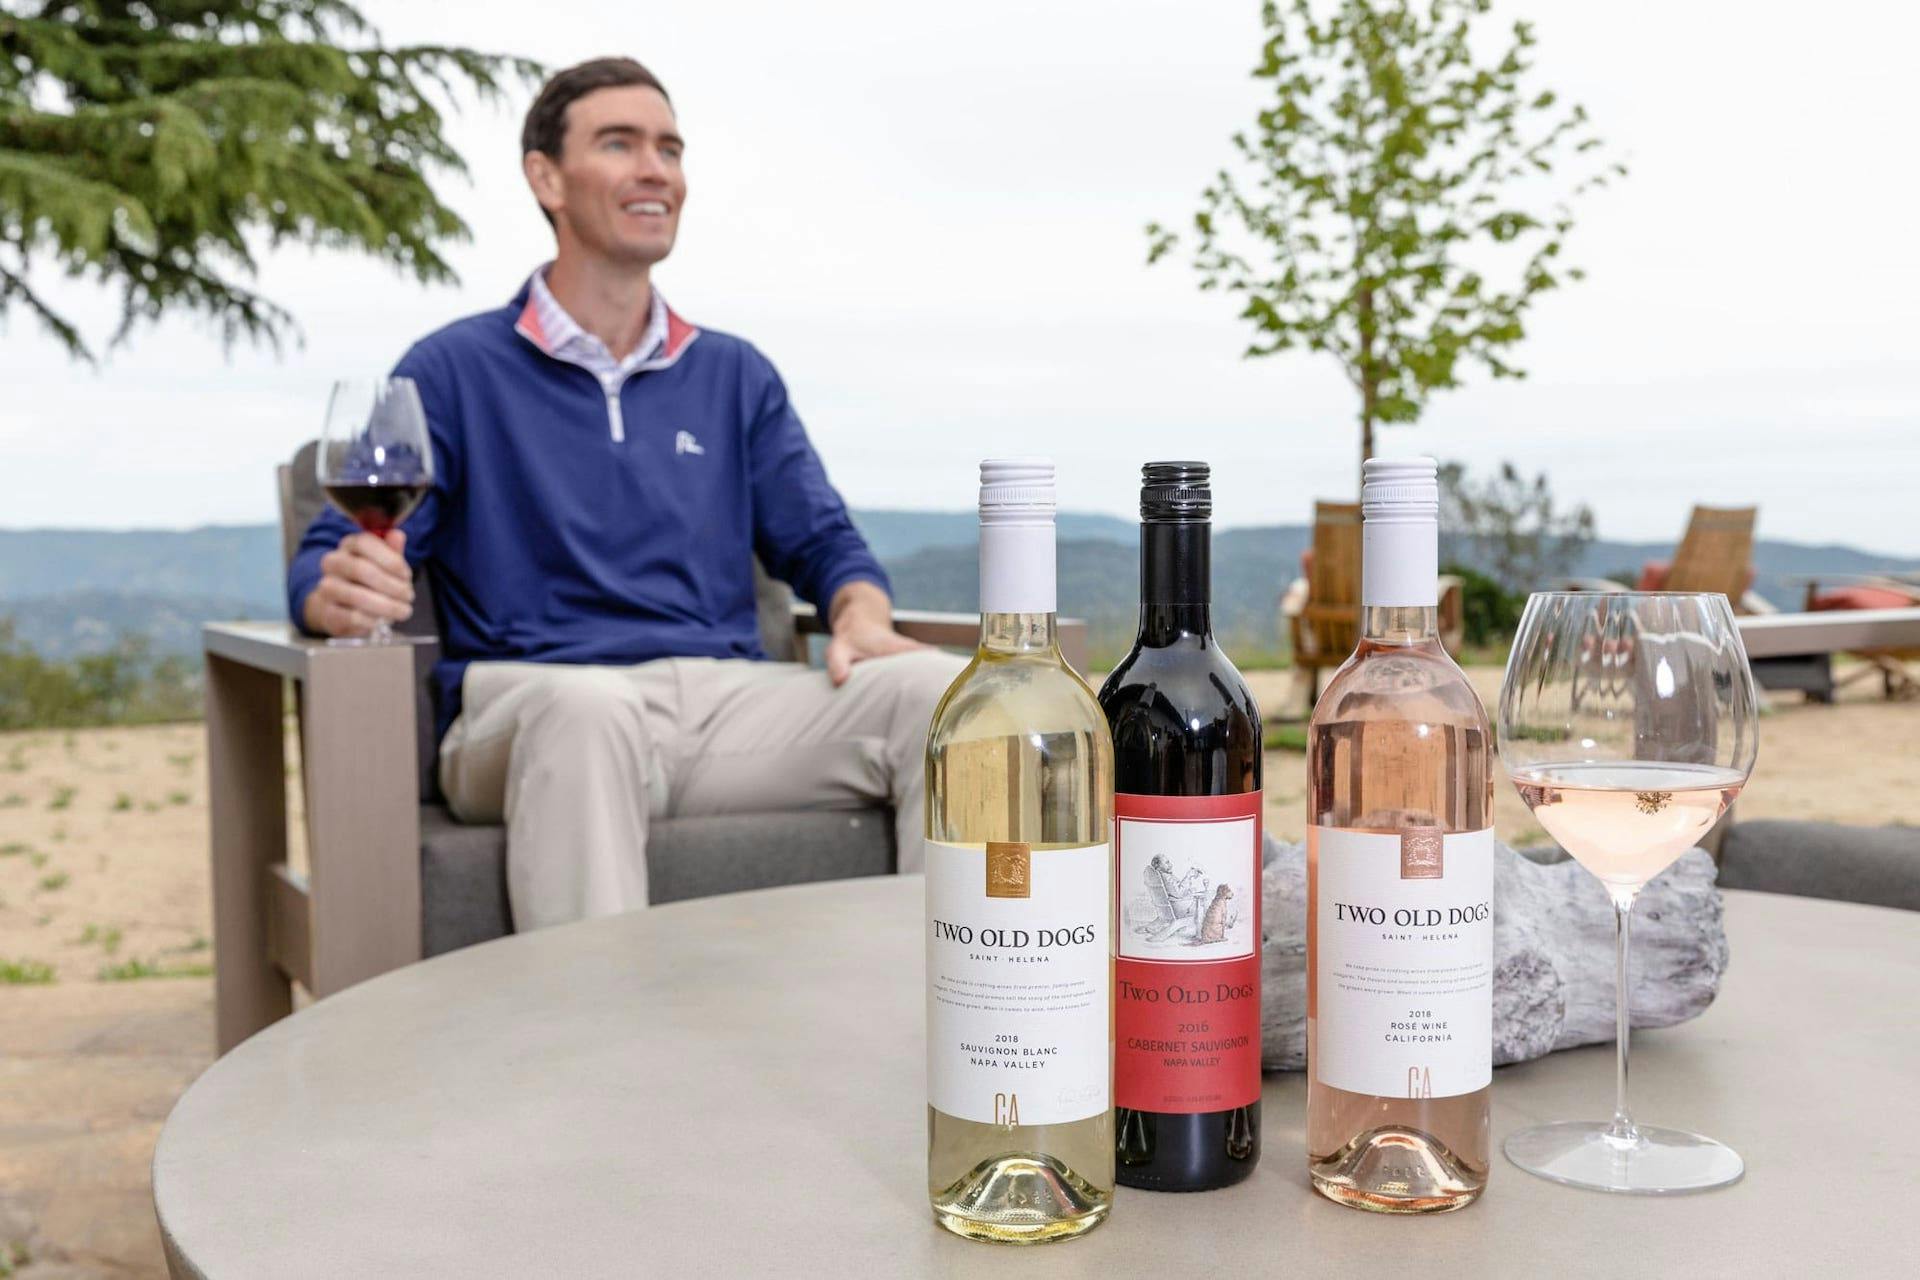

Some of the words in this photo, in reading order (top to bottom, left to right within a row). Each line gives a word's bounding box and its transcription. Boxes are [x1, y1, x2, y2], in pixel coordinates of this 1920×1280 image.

[1335, 902, 1386, 926] TWO
[1394, 909, 1442, 927] OLD
[1448, 902, 1489, 926] DOGS
[934, 919, 973, 945] TWO
[980, 929, 1029, 948] OLD
[1037, 924, 1095, 948] DOGS
[1382, 933, 1412, 941] SAINT
[1422, 933, 1459, 941] HELENA
[969, 953, 998, 962] SAINT
[1008, 955, 1050, 963] HELENA
[1409, 1010, 1432, 1018] 2018
[1178, 1020, 1209, 1033] 2016
[1422, 1022, 1448, 1030] WINE
[995, 1035, 1019, 1043] 2018
[1385, 1034, 1452, 1043] CALIFORNIA
[960, 1043, 1018, 1056] SAUVIGNON
[1023, 1047, 1058, 1056] BLANC
[1127, 1037, 1187, 1053] CABERNET
[1191, 1036, 1249, 1053] SAUVIGNON
[970, 1058, 998, 1068] NAPA
[1003, 1061, 1046, 1069] VALLEY
[1163, 1057, 1188, 1067] NAPA
[1189, 1057, 1221, 1067] VALLEY
